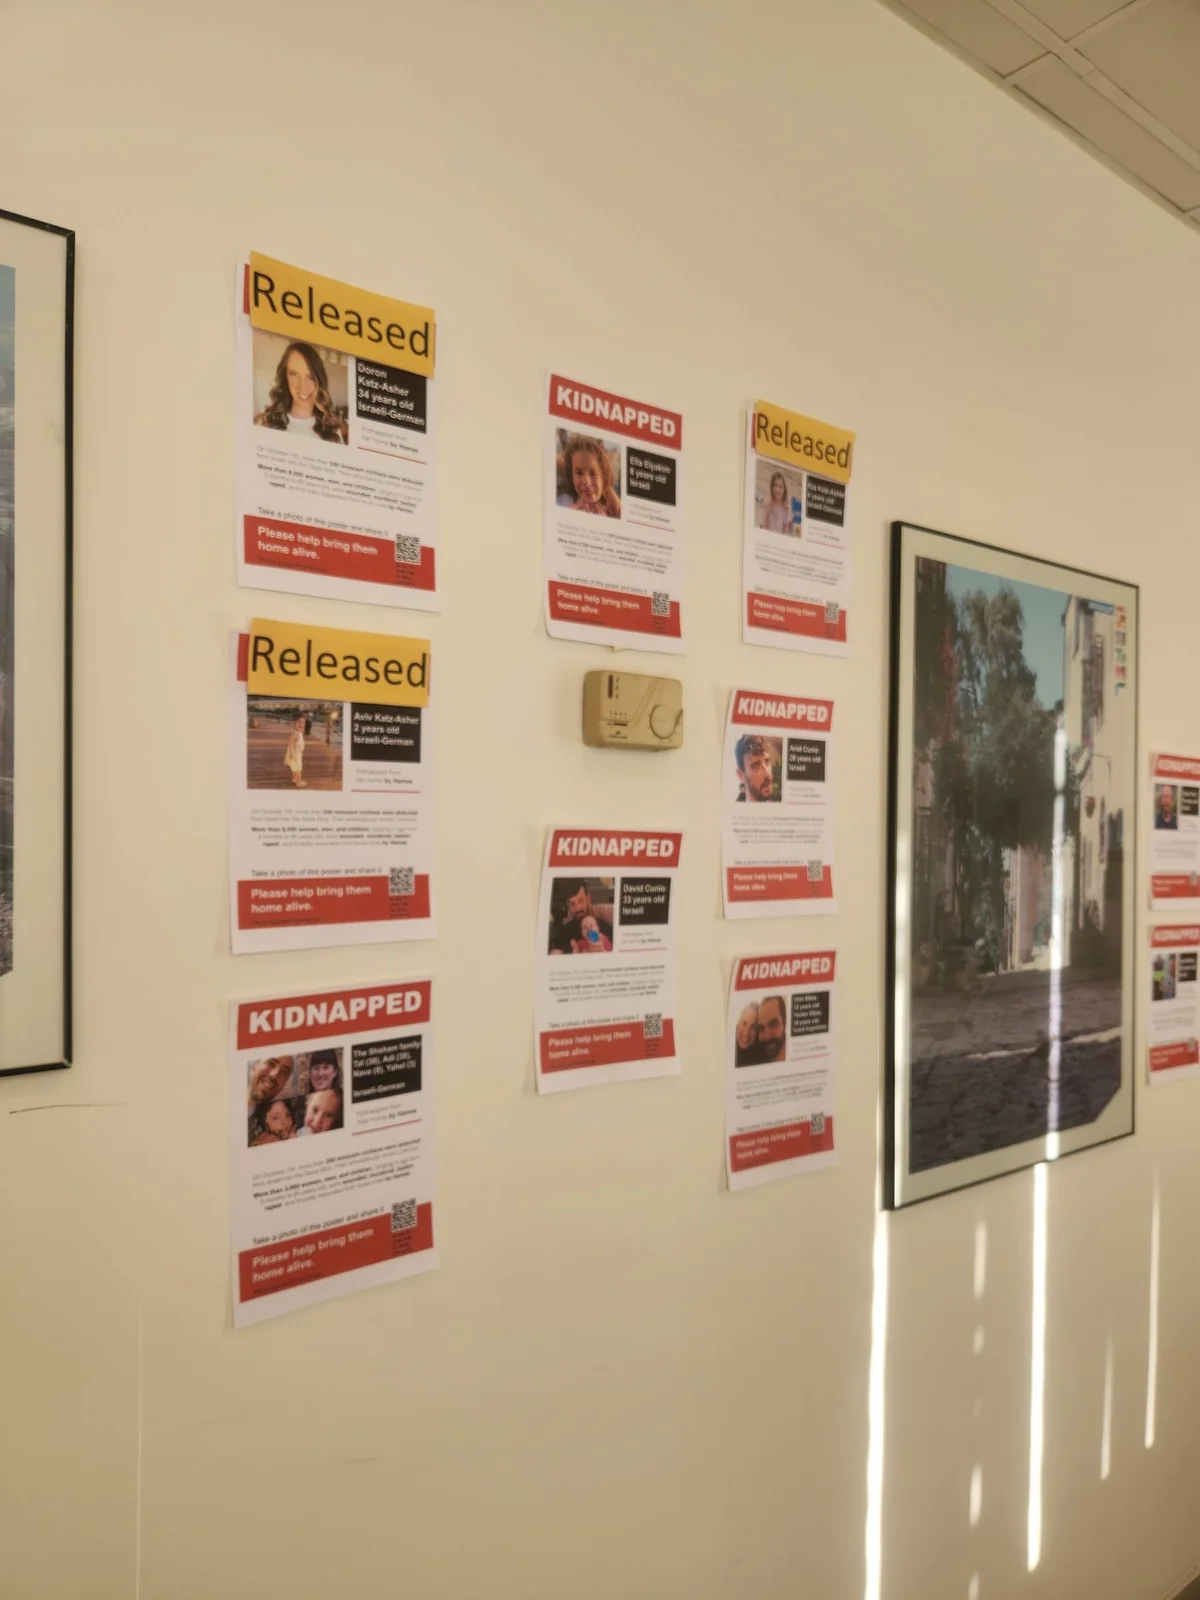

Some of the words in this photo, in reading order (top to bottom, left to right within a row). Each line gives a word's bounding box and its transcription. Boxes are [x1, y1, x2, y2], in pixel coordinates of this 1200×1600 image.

[253, 271, 429, 358] Released
[357, 363, 388, 379] Doron
[357, 375, 410, 397] Katz-Asher
[358, 388, 370, 399] 34
[371, 393, 398, 407] years
[398, 400, 415, 410] old
[358, 401, 425, 426] Israeli-German
[556, 384, 676, 438] KIDNAPPED
[757, 412, 852, 470] Released
[636, 470, 654, 482] years
[655, 474, 666, 484] old
[258, 506, 275, 517] Take
[284, 512, 304, 522] photo
[257, 526, 296, 542] Please
[297, 532, 320, 548] help
[322, 538, 351, 554] bring
[352, 542, 379, 556] them
[257, 540, 290, 555] home
[292, 546, 320, 561] alive.
[556, 588, 583, 602] Please
[584, 592, 601, 605] help
[602, 597, 621, 609] bring
[622, 600, 641, 610] them
[558, 601, 580, 612] home
[252, 635, 427, 689] Released
[354, 712, 374, 722] Aviv
[374, 713, 420, 725] Katz-Asher
[737, 697, 829, 723] KIDNAPPED
[354, 724, 360, 733] 2
[360, 726, 385, 735] years
[386, 726, 400, 735] old
[354, 735, 414, 747] Israeli-German
[556, 836, 675, 858] KIDNAPPED
[251, 870, 268, 878] Take
[276, 868, 297, 878] photo
[250, 888, 288, 900] Please
[290, 888, 314, 898] help
[316, 886, 344, 898] bring
[346, 885, 372, 895] them
[622, 884, 644, 894] David
[644, 884, 666, 894] Cunio
[250, 902, 284, 914] home
[284, 900, 314, 912] alive.
[632, 896, 652, 906] years
[652, 894, 665, 904] old
[622, 906, 644, 916] Israeli
[741, 956, 832, 981] KIDNAPPED
[249, 990, 423, 1035] KIDNAPPED
[548, 1038, 574, 1047] Please
[574, 1034, 592, 1045] help
[592, 1032, 613, 1043] bring
[613, 1030, 632, 1040] them
[548, 1050, 570, 1060] home
[353, 1082, 406, 1099] Israeli-German
[253, 1236, 271, 1246] Take
[278, 1228, 299, 1241] photo
[252, 1250, 290, 1269] Please
[292, 1243, 316, 1259] help
[317, 1236, 347, 1252] bring
[348, 1228, 374, 1242] them
[252, 1266, 286, 1284] home
[286, 1259, 316, 1274] alive.
